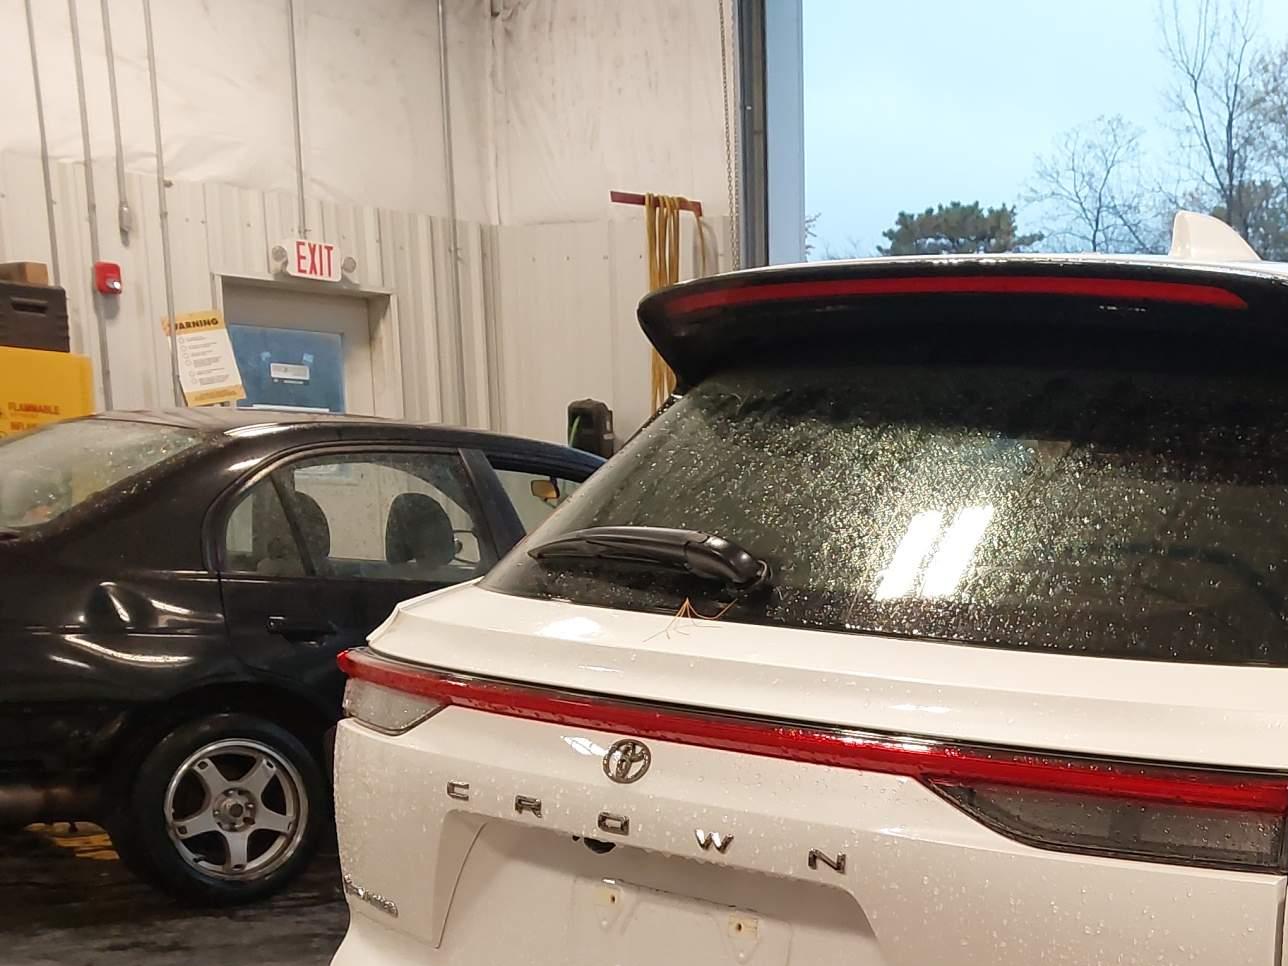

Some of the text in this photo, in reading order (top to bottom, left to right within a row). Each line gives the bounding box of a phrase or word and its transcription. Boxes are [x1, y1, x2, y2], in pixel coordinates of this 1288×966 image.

[295, 240, 334, 278] EXIT
[7, 401, 61, 416] FLAMMABLE
[446, 780, 847, 874] CROWN
